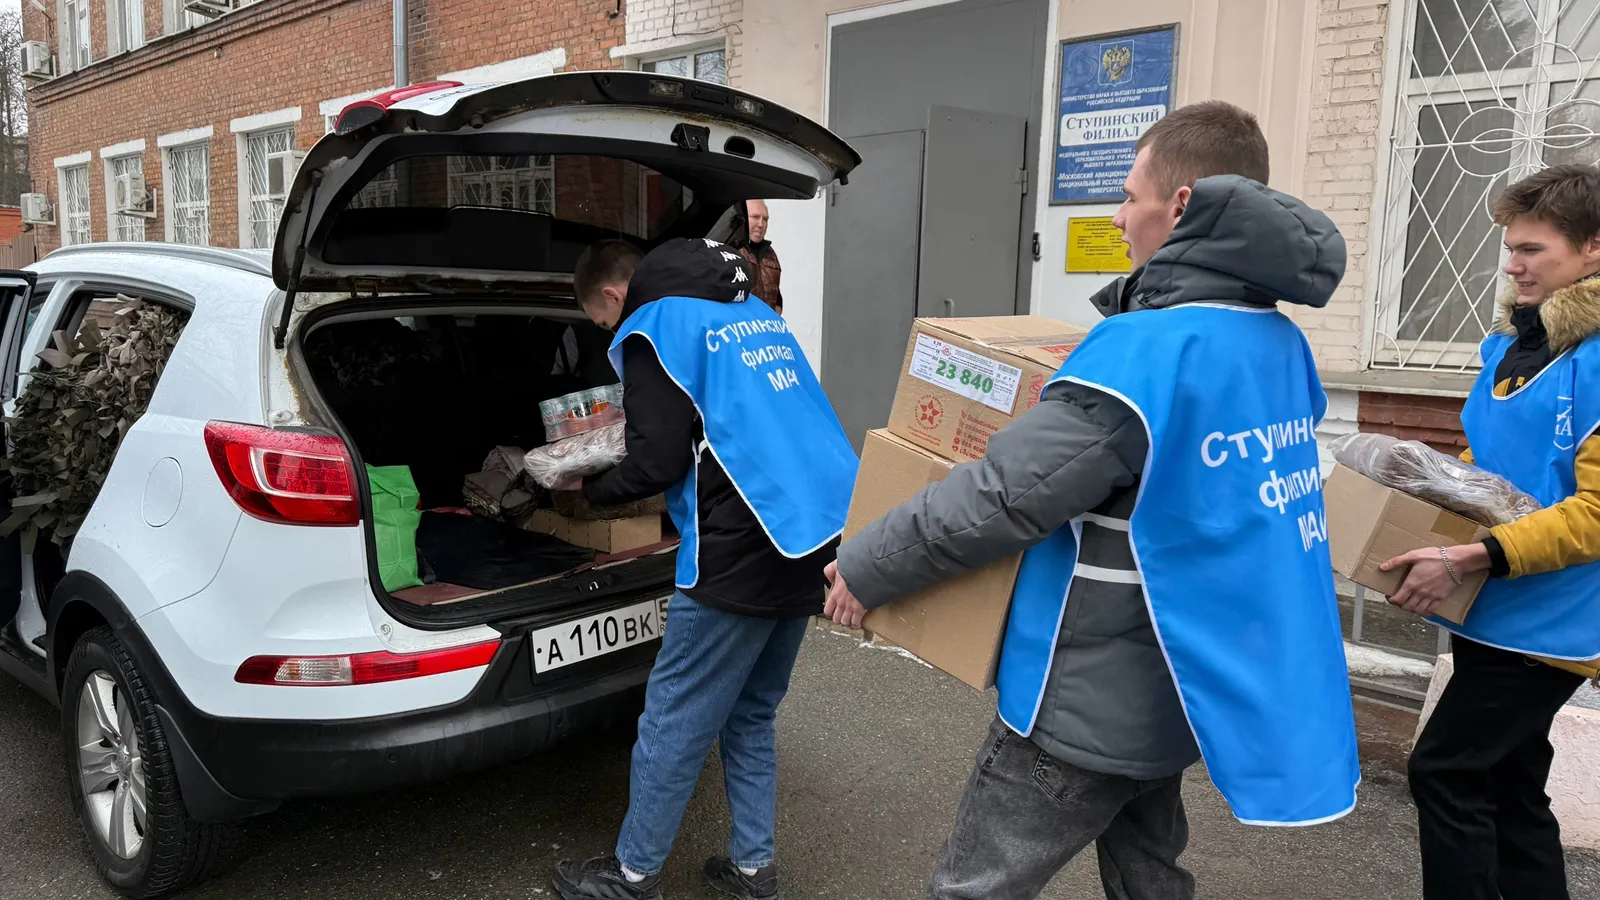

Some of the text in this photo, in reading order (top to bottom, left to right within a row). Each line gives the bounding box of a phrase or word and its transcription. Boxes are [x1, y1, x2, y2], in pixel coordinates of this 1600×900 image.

[1066, 108, 1160, 130] СТУПИНСКИЙ
[1083, 126, 1139, 140] ФИЛИАЛ
[767, 367, 800, 392] МА
[935, 359, 957, 380] 23
[960, 369, 993, 394] 840
